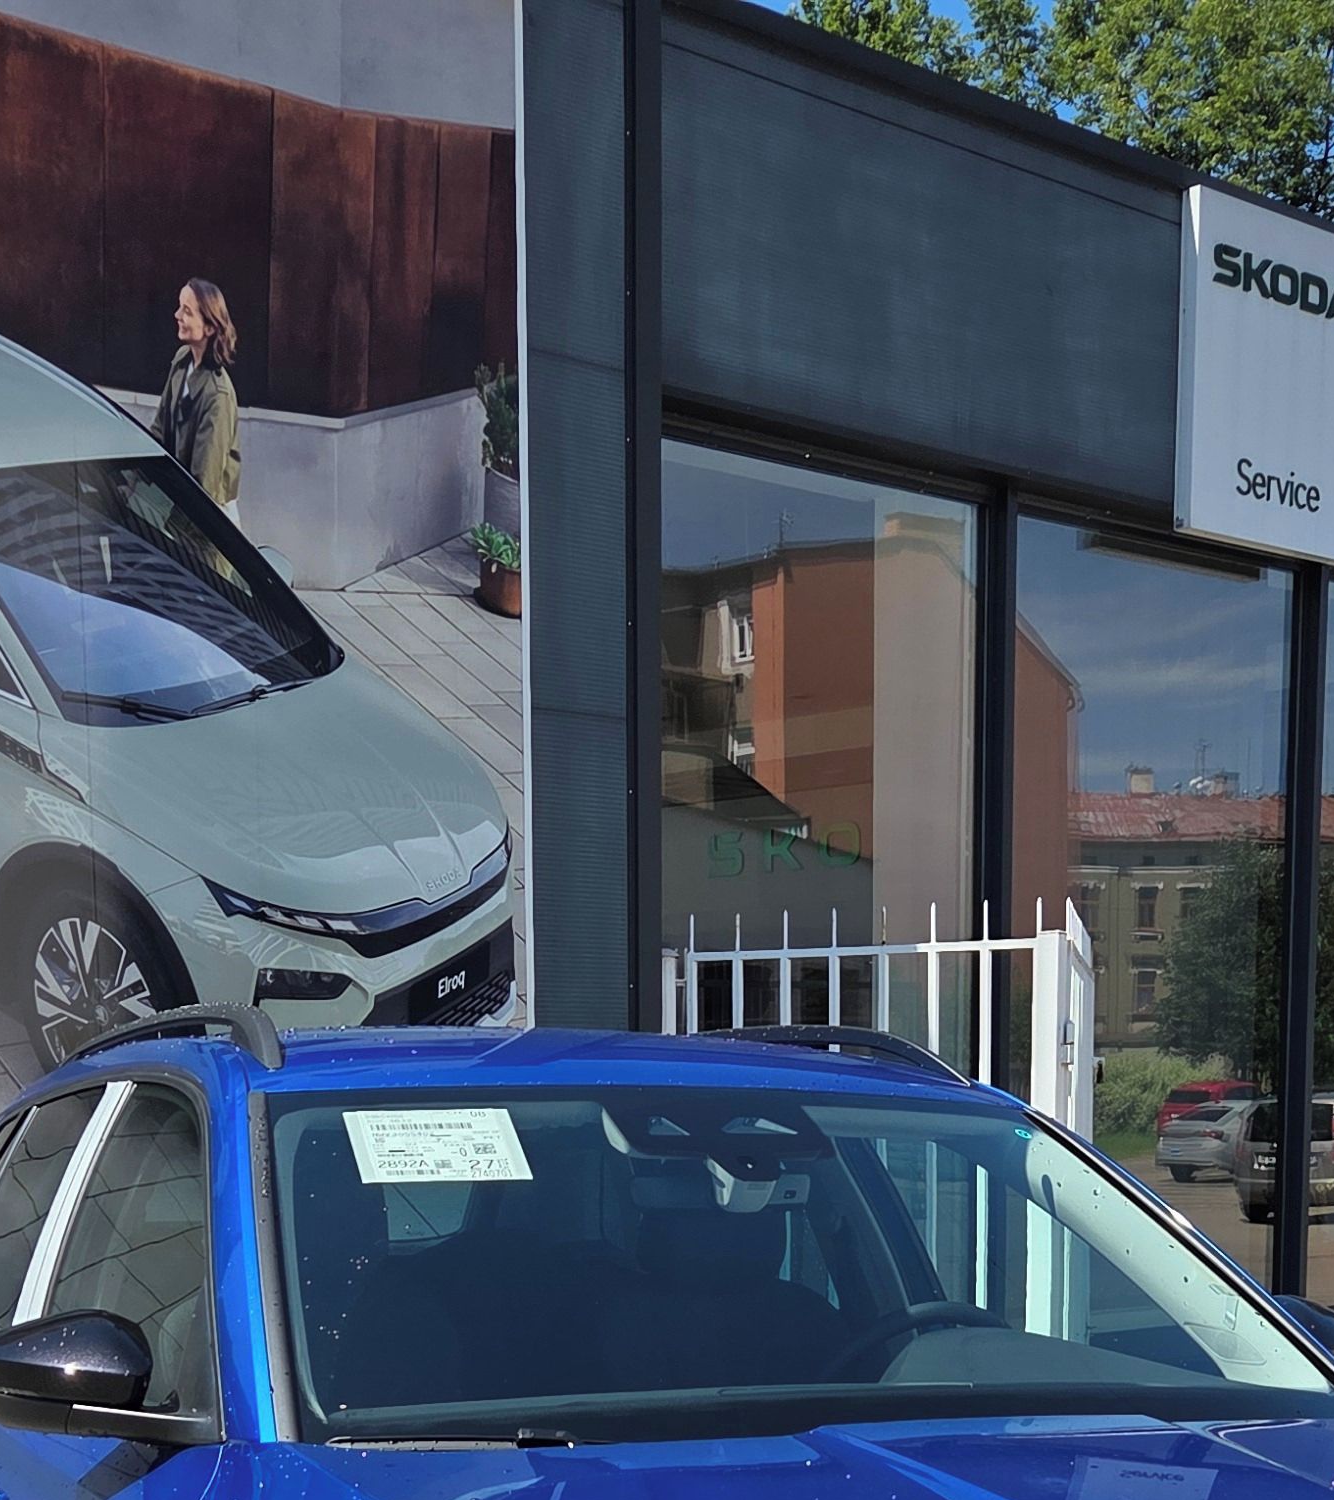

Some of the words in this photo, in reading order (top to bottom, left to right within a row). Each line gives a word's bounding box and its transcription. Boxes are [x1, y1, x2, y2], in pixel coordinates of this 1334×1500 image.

[1236, 458, 1320, 512] Service
[438, 970, 465, 998] Elroq
[378, 1160, 429, 1168] 2892A
